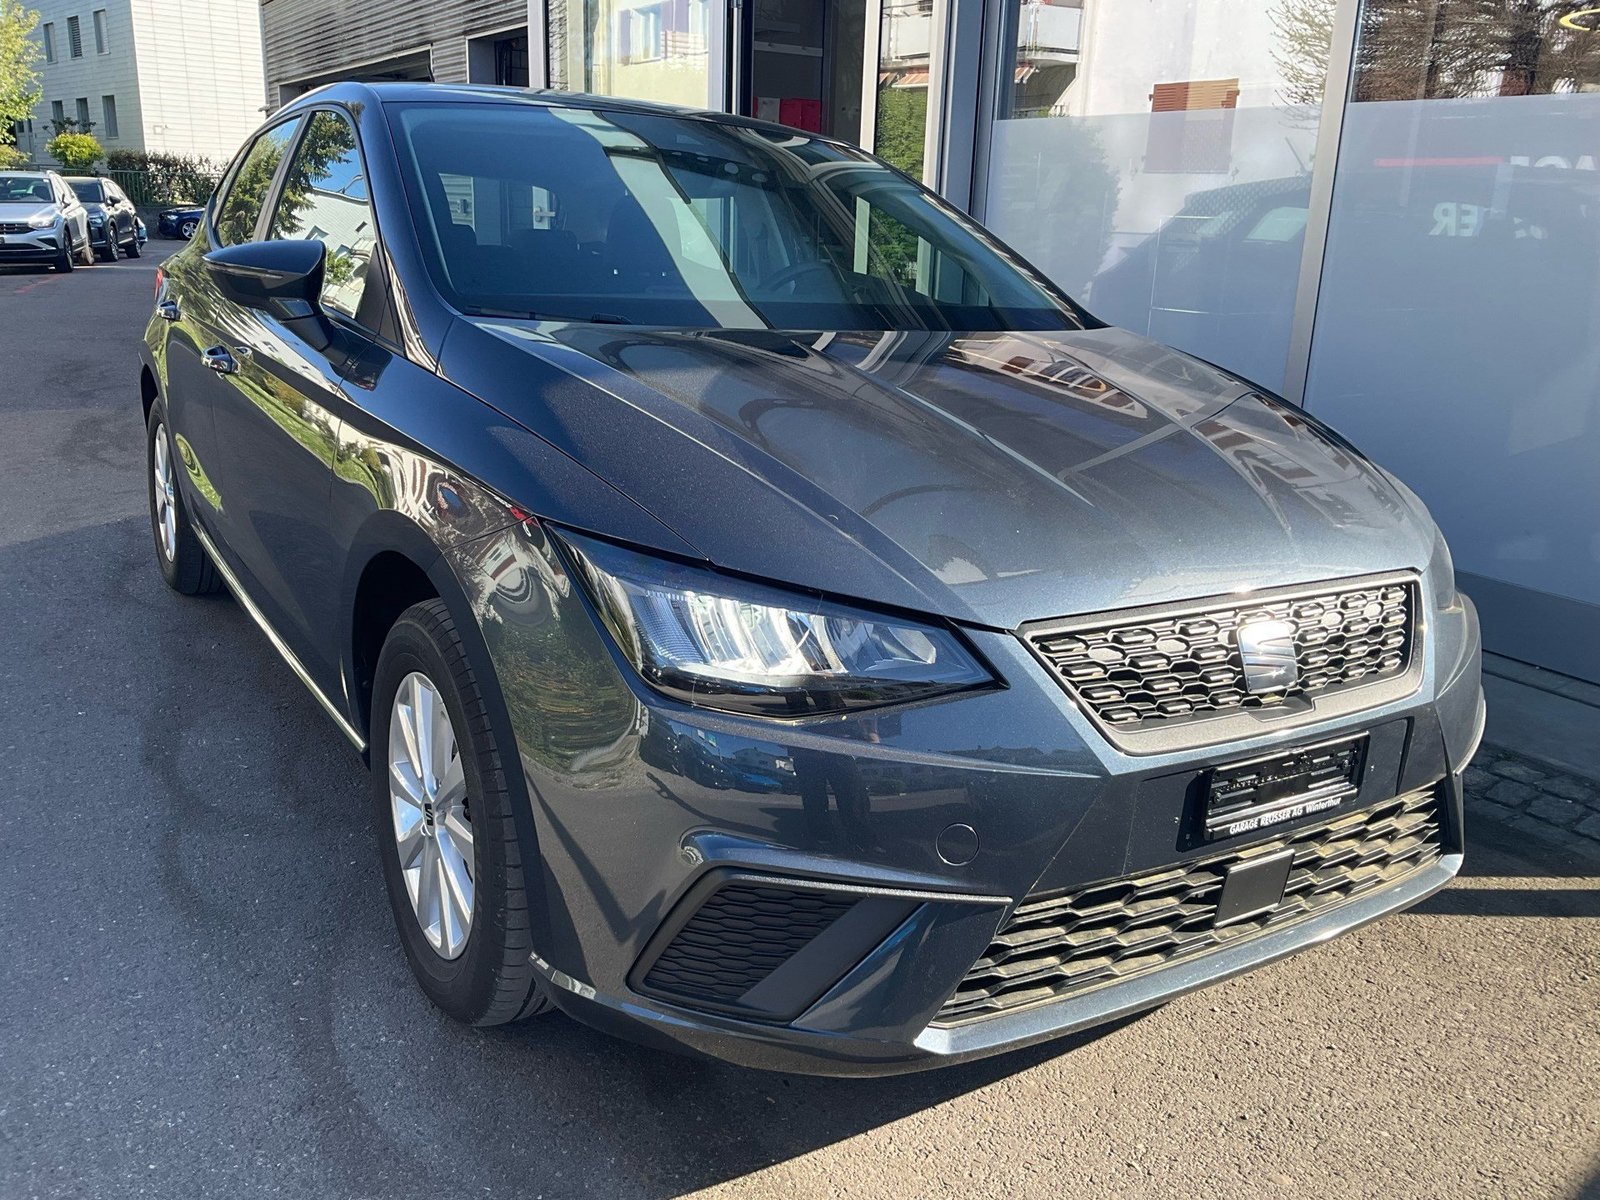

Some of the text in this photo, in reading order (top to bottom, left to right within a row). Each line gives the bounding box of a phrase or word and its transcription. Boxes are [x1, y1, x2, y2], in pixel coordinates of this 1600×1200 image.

[1229, 797, 1342, 835] GARAGE REUSSER AG Winterthur
